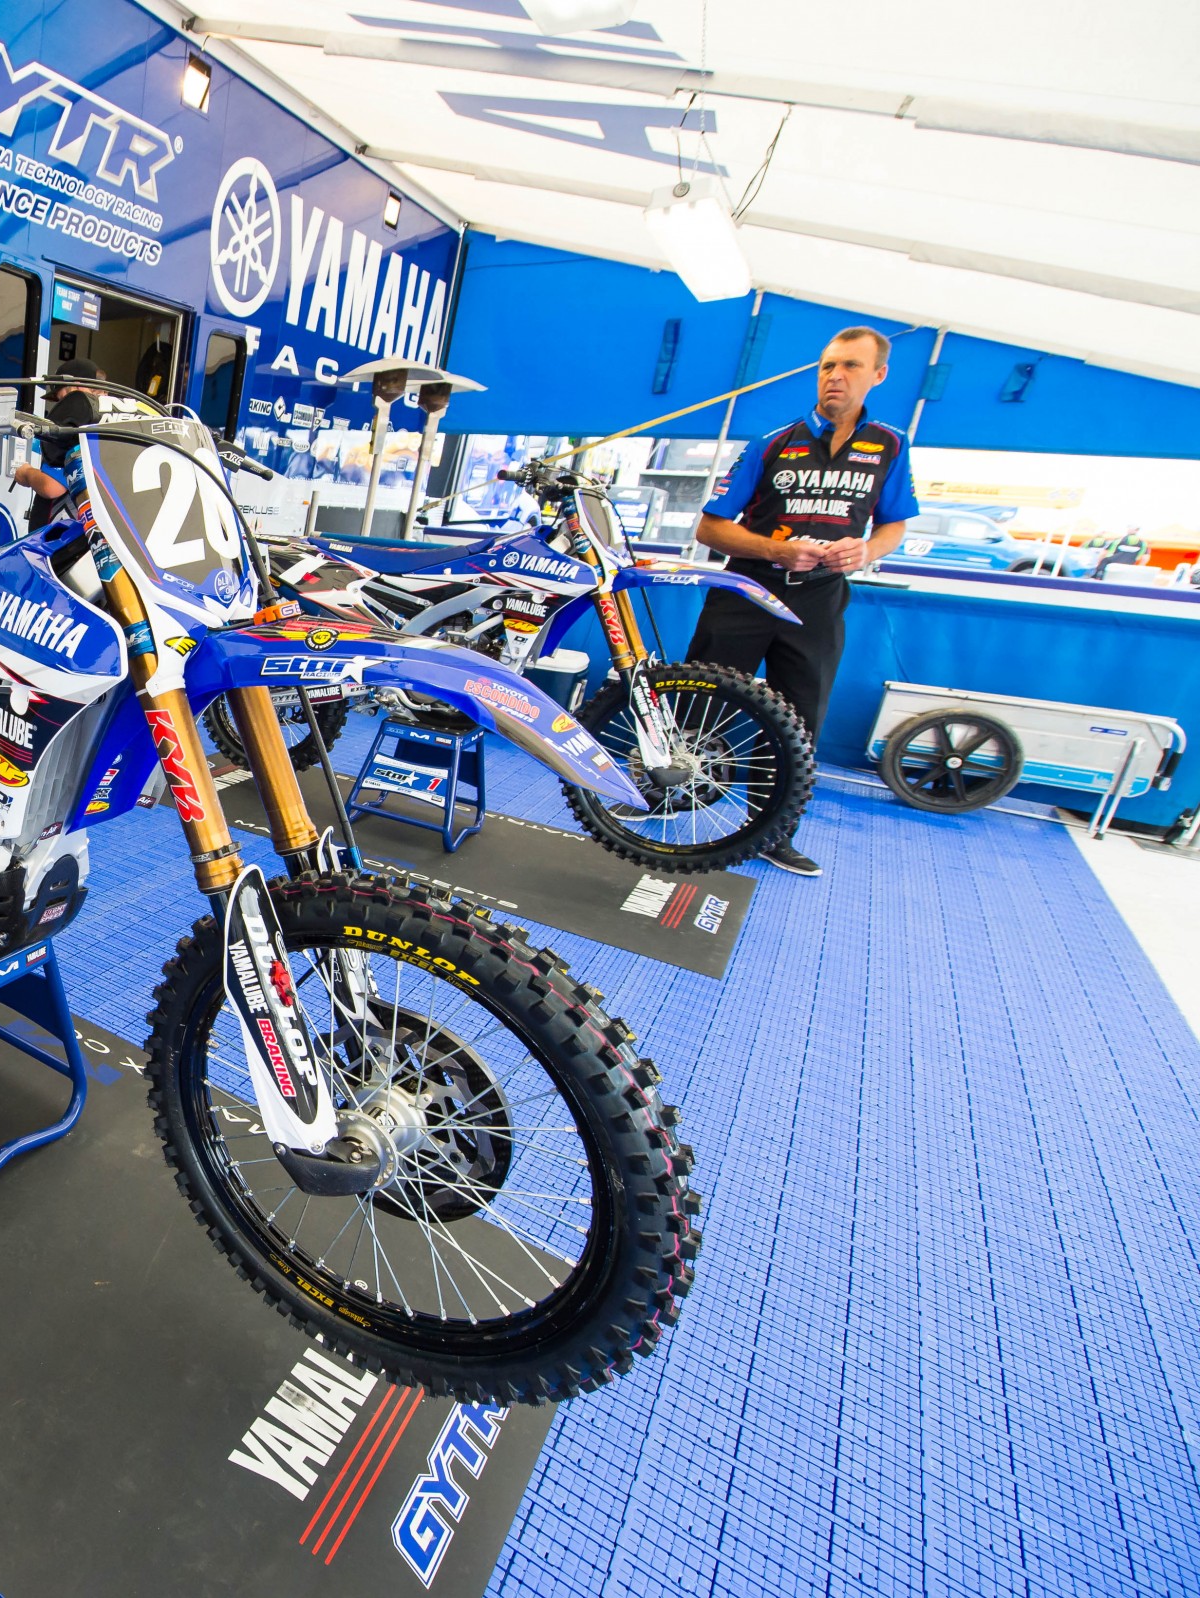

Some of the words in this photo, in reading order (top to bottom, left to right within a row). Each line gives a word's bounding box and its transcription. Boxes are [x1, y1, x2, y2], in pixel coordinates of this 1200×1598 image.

[14, 153, 115, 213] TECHNOLOGY
[112, 198, 163, 233] RACING
[48, 200, 163, 267] PRODUCTS
[55, 285, 67, 299] TEAM
[67, 290, 81, 302] STAFF
[286, 193, 447, 371] YAMAHA
[218, 451, 244, 466] ARC
[780, 488, 867, 499] RACING
[798, 469, 875, 493] YAMAHA
[785, 498, 850, 517] YAMALUBE
[518, 554, 580, 580] YAMAHA
[505, 597, 547, 618] YAMALUBE
[599, 598, 626, 646] KYB
[261, 656, 350, 674] star
[307, 686, 340, 698] YAMALUBE
[464, 679, 540, 719] ESCONDIDO
[492, 682, 529, 702] TOYOTA
[655, 679, 718, 690] DUNLOP
[499, 705, 535, 723] SPORTS
[145, 709, 207, 823] KYB
[426, 777, 443, 791] 1
[362, 858, 519, 910] ONCEPTS
[694, 894, 730, 935] GYTR
[342, 925, 481, 986] DUNLOP
[389, 949, 438, 975] EXCEL
[228, 939, 270, 1014] YAMALUBE
[256, 1018, 296, 1098] BRAKING
[296, 1275, 335, 1308] EXCEL
[227, 1336, 379, 1502] YAMAL
[390, 1398, 511, 1591] GYTR
